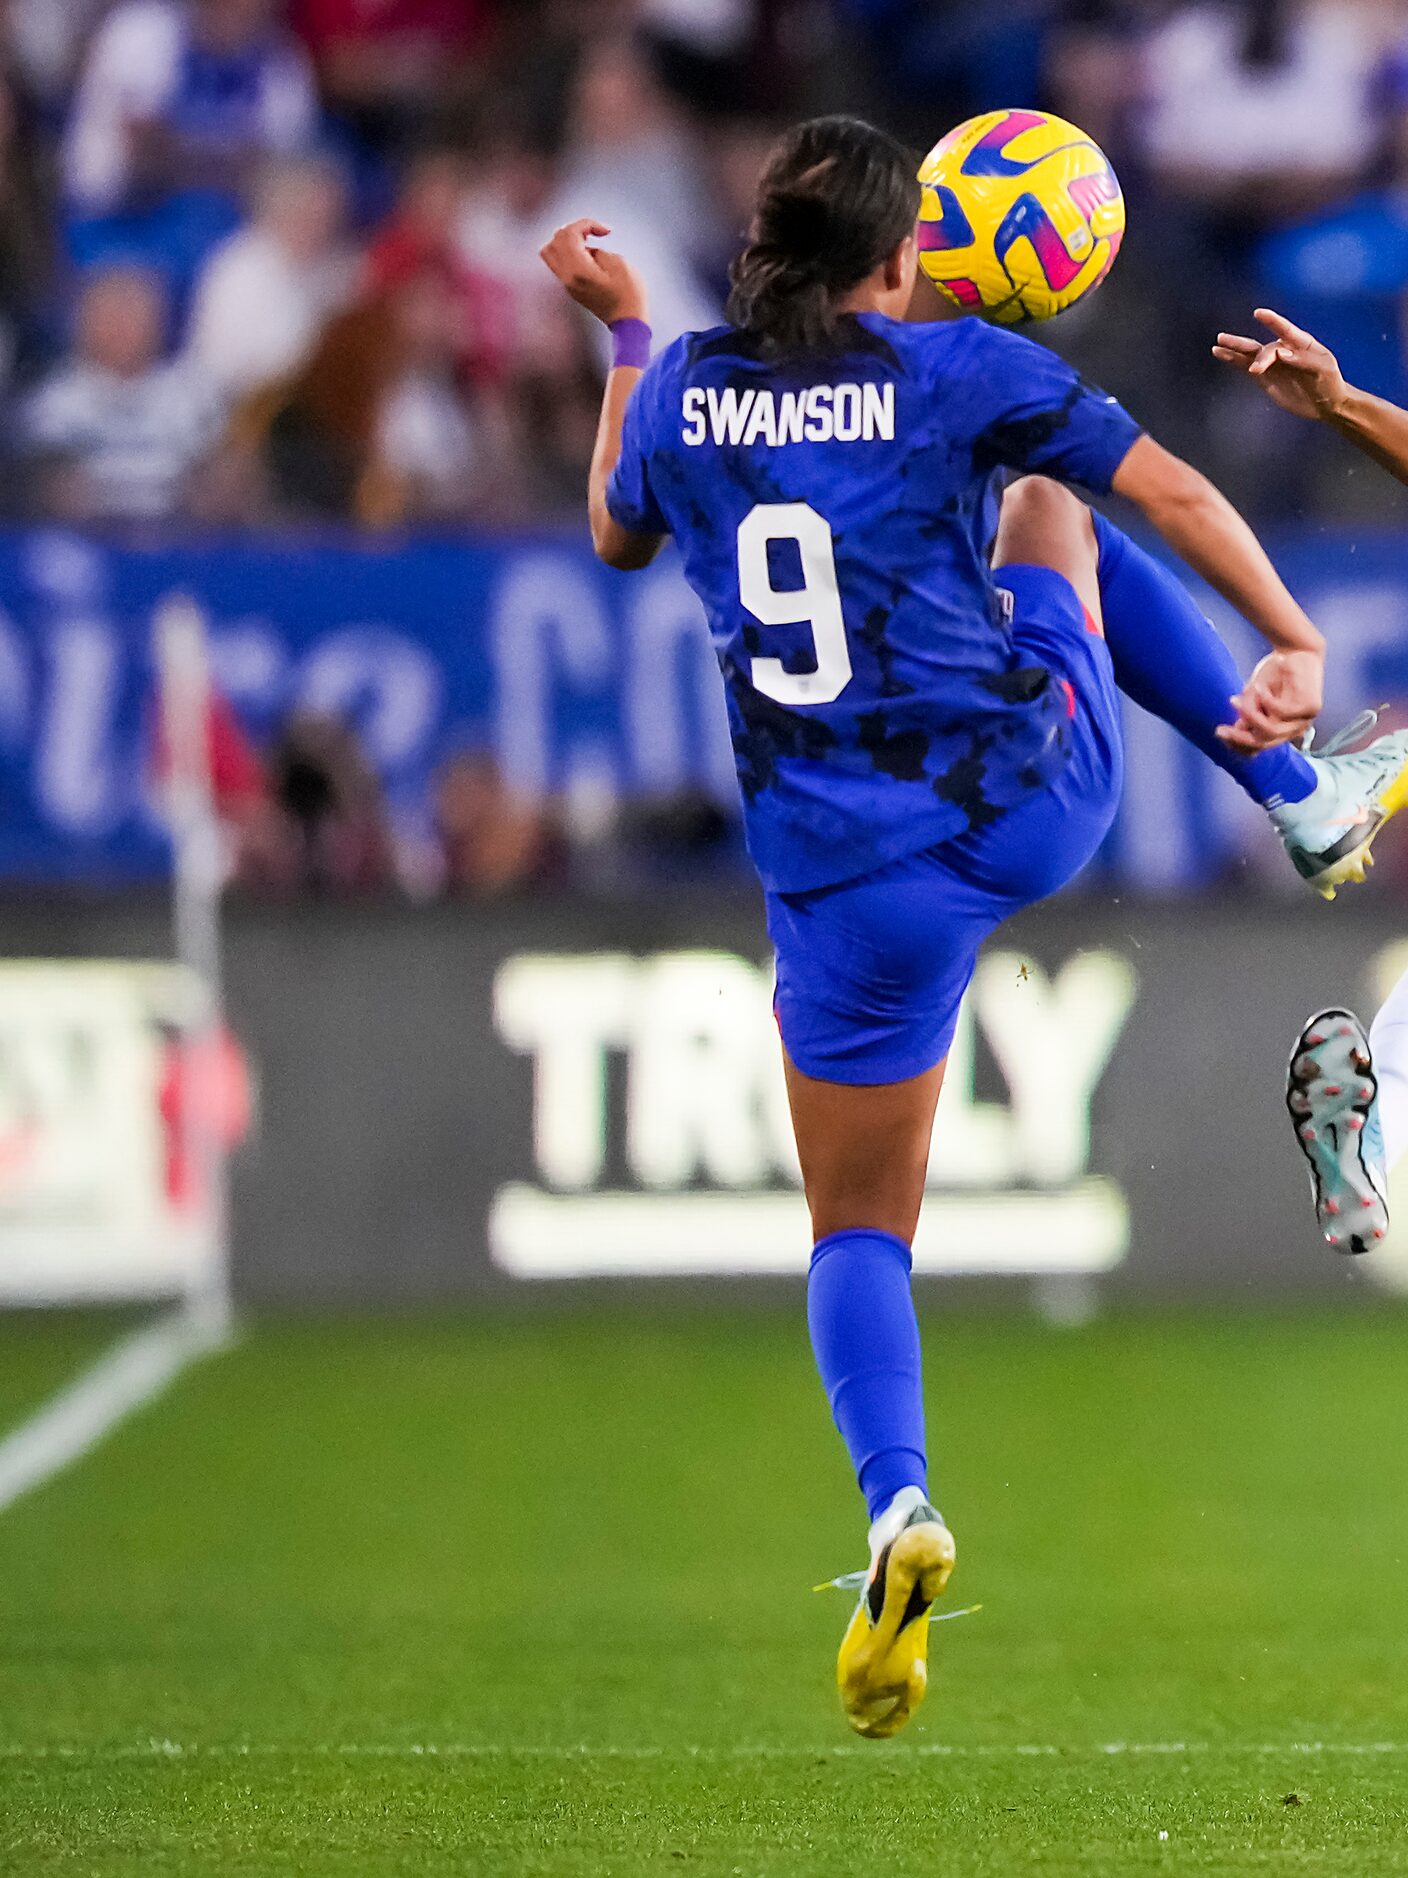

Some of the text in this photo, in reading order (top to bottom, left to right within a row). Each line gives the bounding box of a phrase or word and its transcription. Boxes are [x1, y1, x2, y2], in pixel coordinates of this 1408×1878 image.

[682, 382, 895, 447] SWANSON
[737, 502, 853, 706] 9
[493, 950, 1139, 1188] TRLY
